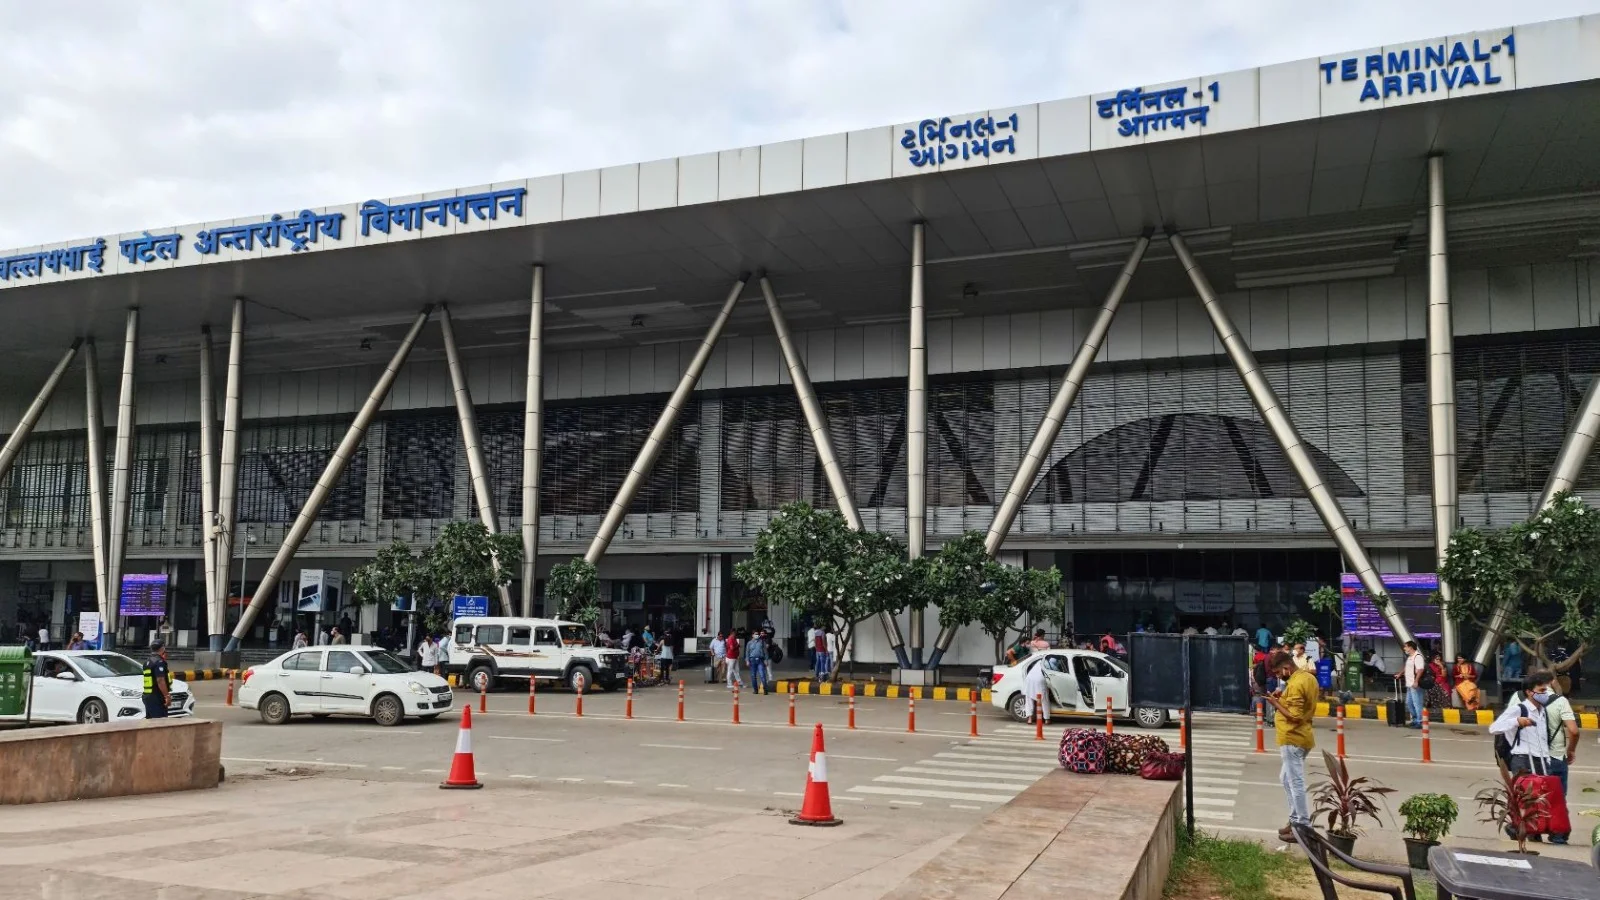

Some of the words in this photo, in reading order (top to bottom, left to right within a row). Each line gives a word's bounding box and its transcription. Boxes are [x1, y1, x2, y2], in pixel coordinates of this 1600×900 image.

[1320, 34, 1516, 84] TERMINAL-1
[1360, 62, 1501, 102] ARRIVAL
[1118, 105, 1210, 137] आगमन
[909, 134, 1016, 167] આગમન
[119, 230, 183, 264] पटेल
[360, 187, 527, 237] विमानपत्तन
